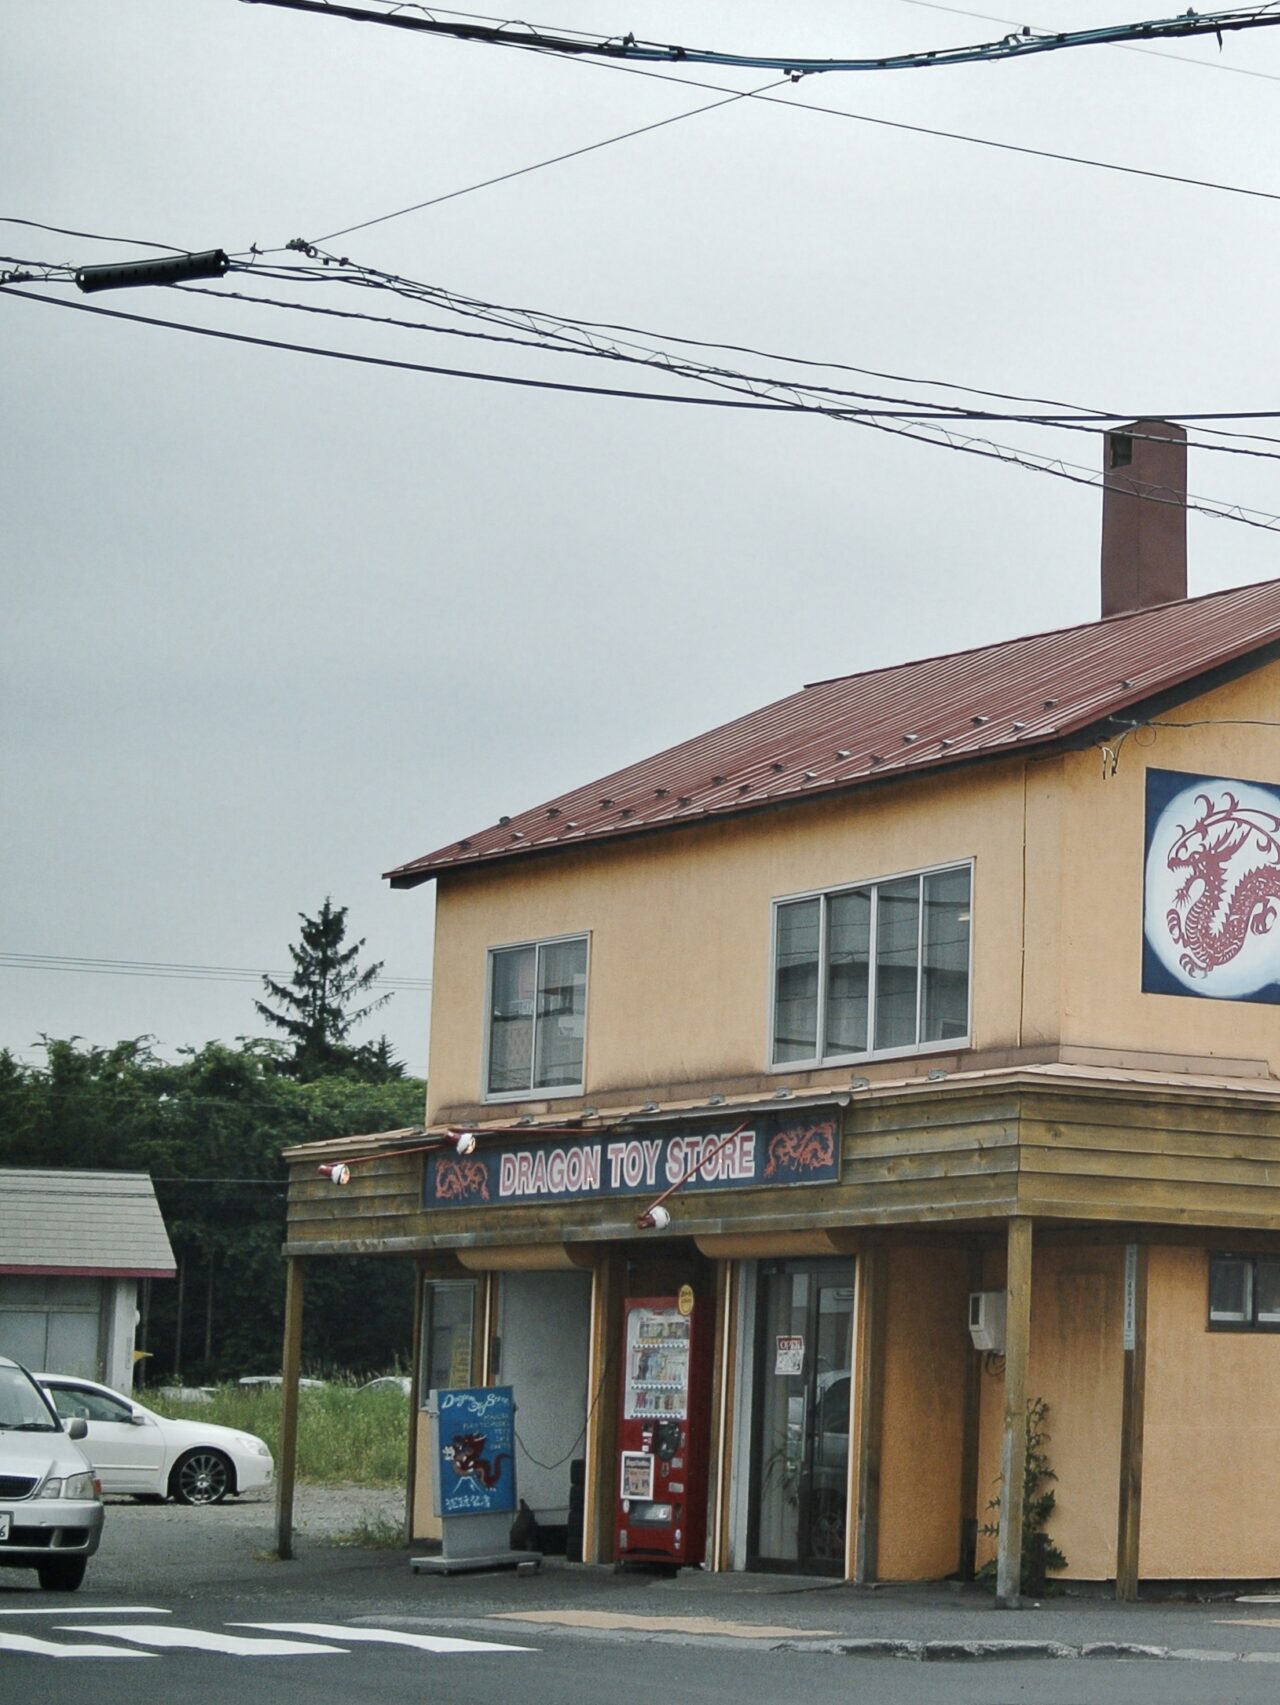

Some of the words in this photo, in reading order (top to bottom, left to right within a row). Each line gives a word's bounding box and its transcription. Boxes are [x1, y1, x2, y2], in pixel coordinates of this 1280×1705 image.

[500, 1145, 600, 1196] DRAGON
[608, 1139, 661, 1189] TOY
[666, 1131, 756, 1184] STORE
